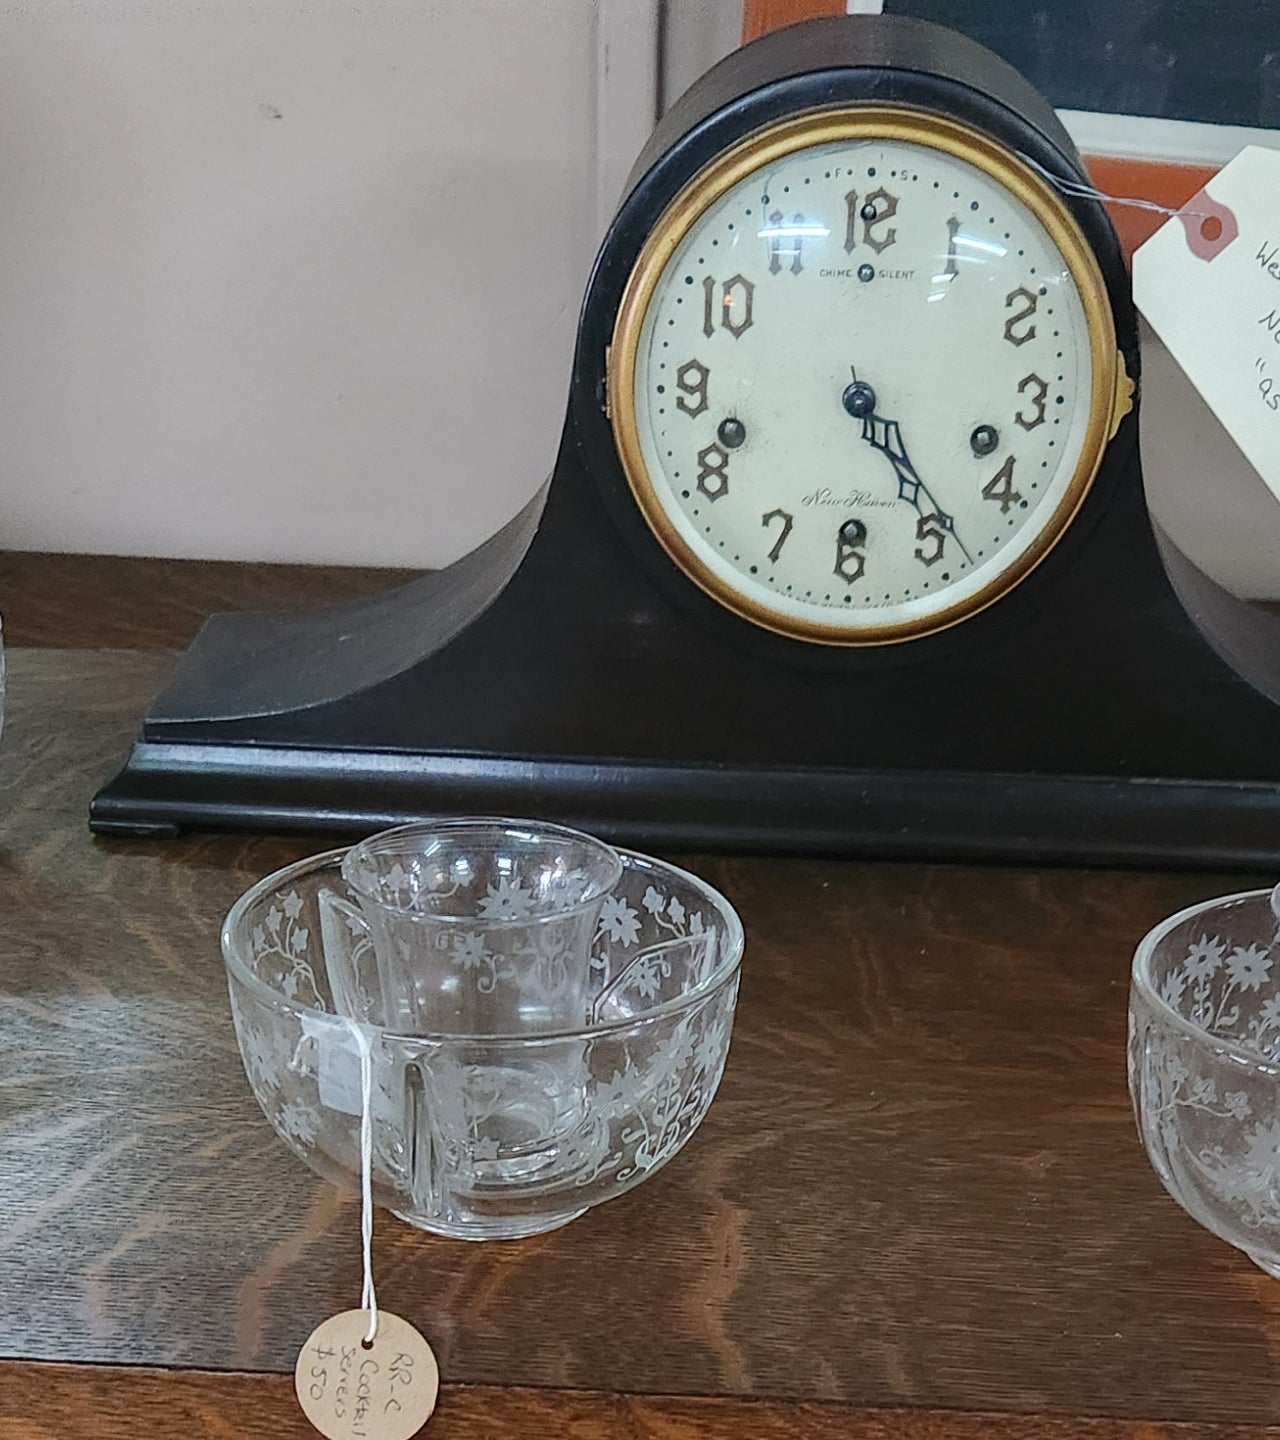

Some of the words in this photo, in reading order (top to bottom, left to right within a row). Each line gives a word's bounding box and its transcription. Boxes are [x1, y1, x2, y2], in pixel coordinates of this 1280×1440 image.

[843, 186, 900, 256] 12
[819, 269, 852, 278] CHIME
[878, 271, 915, 280] SILENT
[702, 273, 755, 339] 10
[1003, 286, 1038, 347] 2
[676, 358, 710, 419] 9
[1014, 372, 1049, 432] 3
[697, 441, 729, 503] 8
[801, 487, 841, 508] New
[842, 489, 897, 509] Haven
[981, 454, 1022, 515] 4
[761, 508, 794, 564] 7
[833, 530, 866, 586] 6
[914, 512, 946, 568] 5
